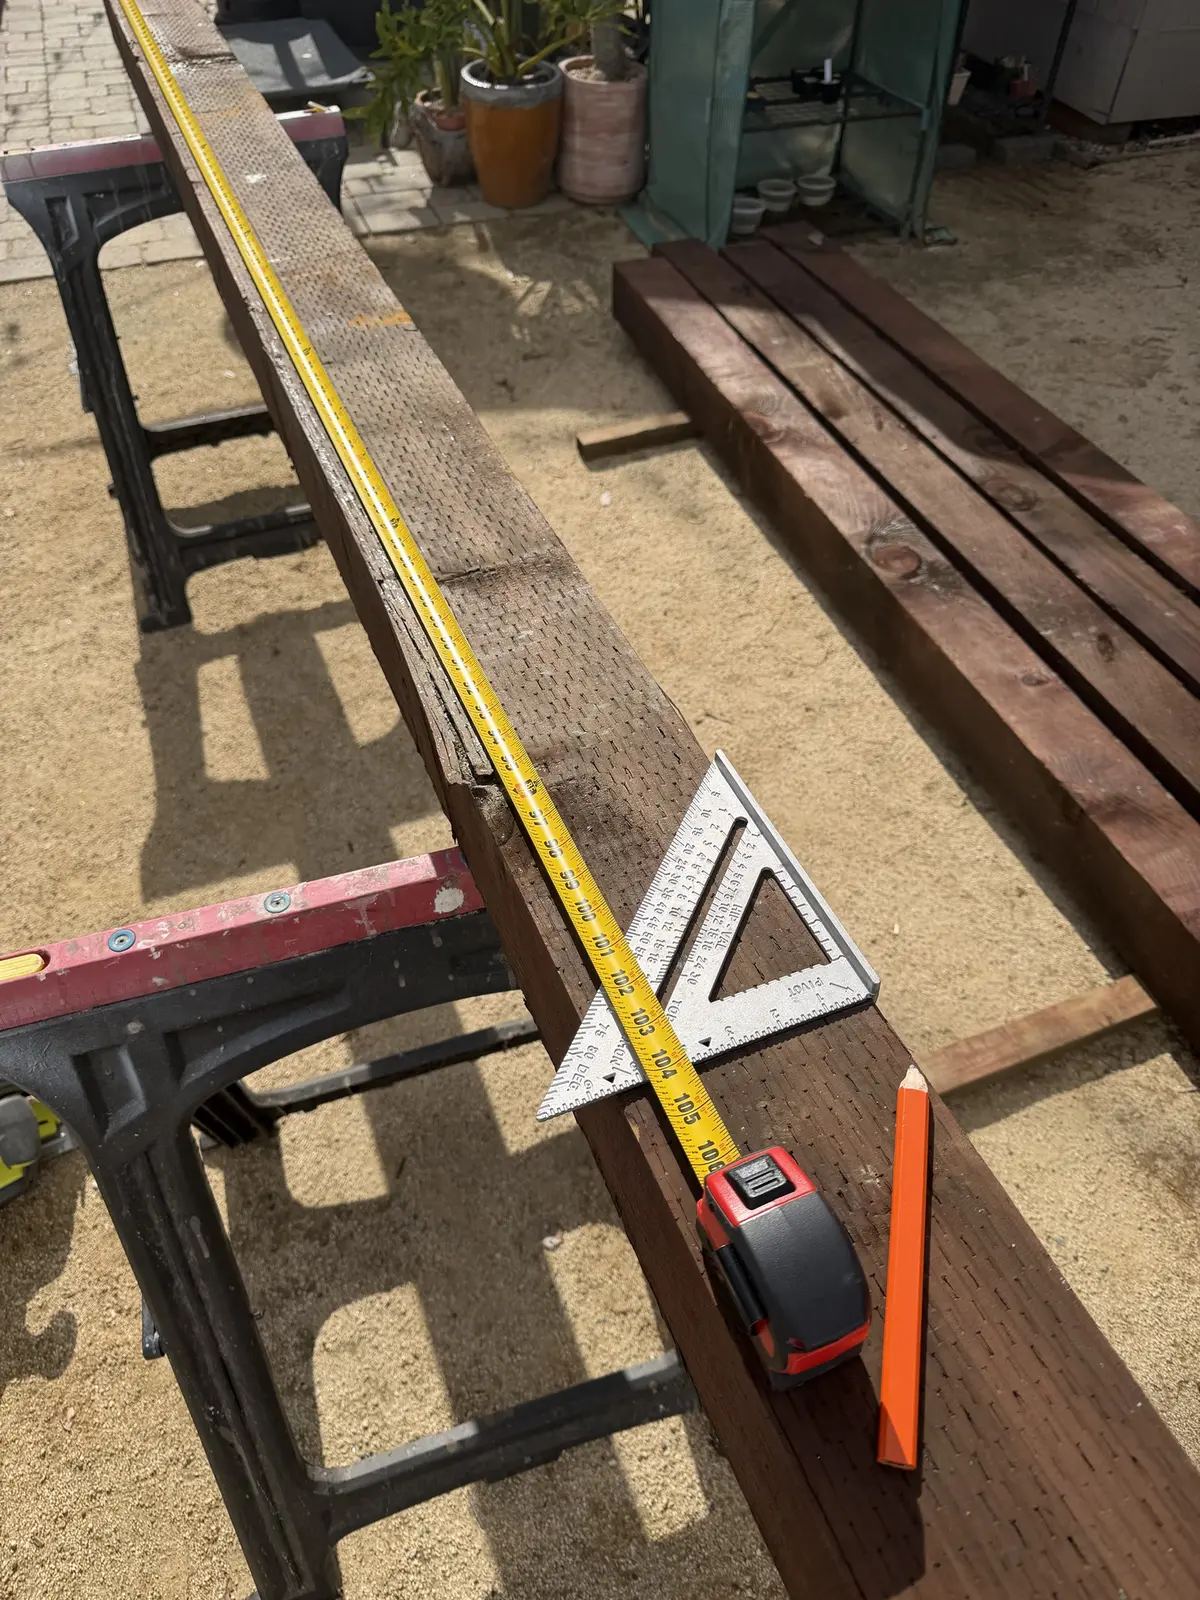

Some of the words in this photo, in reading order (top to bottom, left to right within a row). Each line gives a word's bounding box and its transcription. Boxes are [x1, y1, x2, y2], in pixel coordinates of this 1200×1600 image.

[711, 790, 721, 798] 5
[700, 809, 712, 819] 10
[691, 827, 703, 837] 15
[683, 842, 696, 855] 20
[675, 858, 689, 872] 25
[668, 872, 682, 886] 30
[661, 887, 675, 901] 35
[654, 901, 667, 915] 40
[729, 903, 743, 922] HIP
[646, 916, 660, 930] 45
[639, 931, 654, 945] 50
[715, 931, 732, 950] VAL
[529, 809, 548, 826] 97
[544, 838, 563, 858] 98
[560, 869, 580, 890] 99
[575, 898, 596, 921] 100
[592, 932, 615, 957] 101
[611, 969, 635, 996] 102
[631, 1008, 655, 1036] 103
[651, 1048, 677, 1080] 104
[674, 1093, 702, 1125] 105
[787, 976, 824, 997] PIVOT
[816, 993, 824, 1003] 1
[770, 1008, 780, 1018] 2
[595, 1023, 610, 1038] 75
[724, 1025, 735, 1036] 3
[584, 1045, 599, 1060] 80
[566, 1064, 589, 1092] DEG.
[584, 1079, 594, 1090] 6
